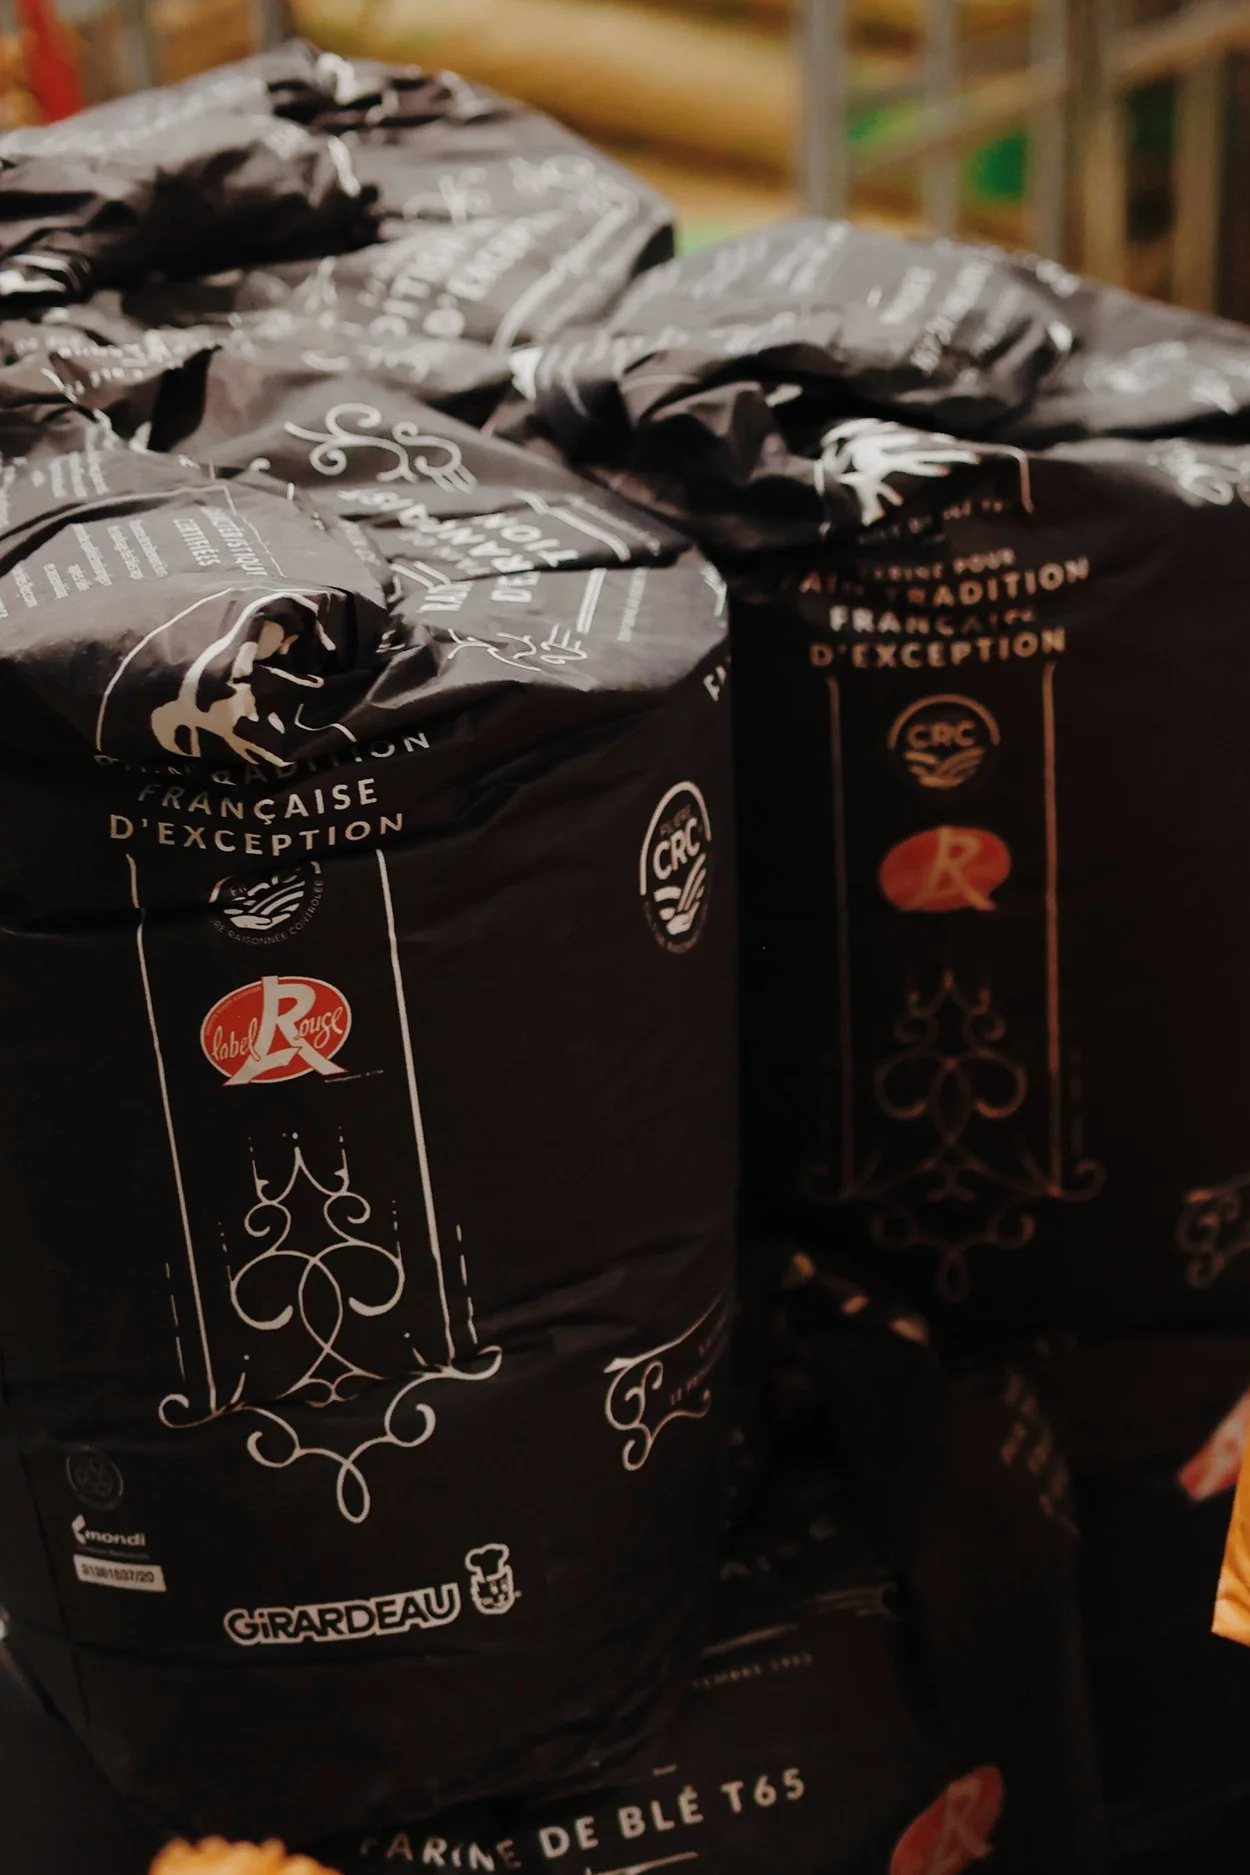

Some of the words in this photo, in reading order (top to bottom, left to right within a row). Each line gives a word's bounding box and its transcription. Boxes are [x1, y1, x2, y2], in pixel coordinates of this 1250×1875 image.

[809, 627, 1066, 669] D'EXCEPTION
[138, 778, 379, 826] FRANÇAISE
[108, 813, 404, 859] D'EXCEPTION
[651, 818, 704, 881] CRC
[361, 1830, 523, 1874] ARINE
[539, 1816, 599, 1859] DE
[616, 1785, 703, 1841] BLÉ
[717, 1766, 807, 1815] T65
